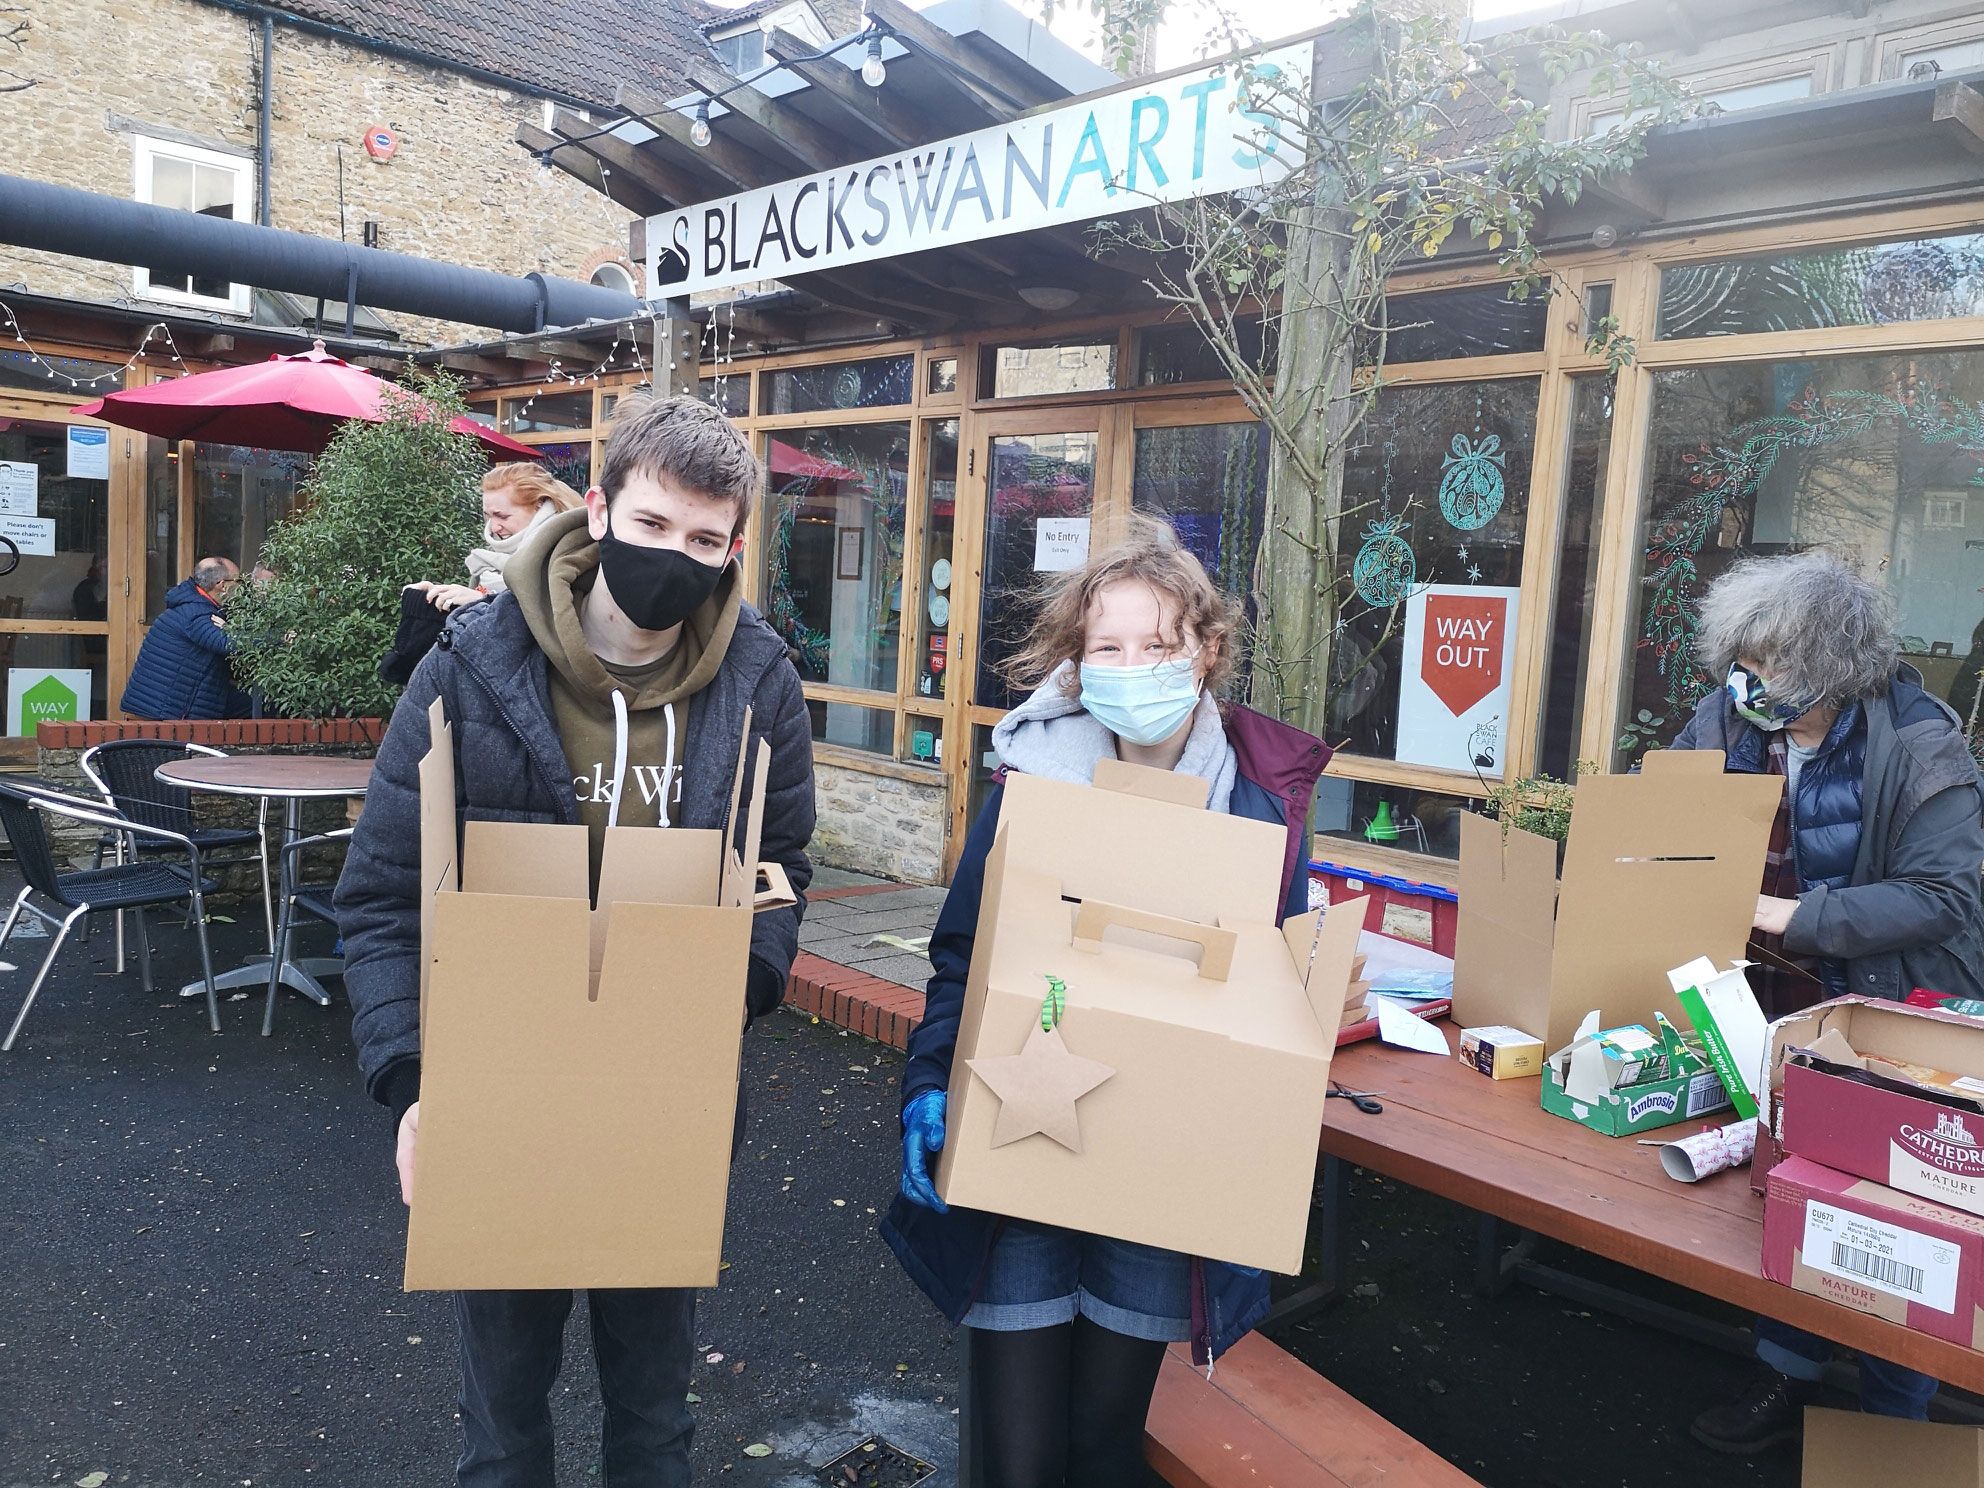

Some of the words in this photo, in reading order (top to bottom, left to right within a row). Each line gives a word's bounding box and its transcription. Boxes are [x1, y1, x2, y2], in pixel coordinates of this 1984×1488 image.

[22, 530, 39, 538] chairs
[1045, 532, 1056, 541] No
[1058, 532, 1080, 543] Entry
[1436, 617, 1493, 641] WAY
[932, 656, 944, 665] PRS
[1436, 644, 1490, 669] OUT
[30, 702, 69, 714] WAY
[1476, 723, 1497, 731] BLACK
[1476, 730, 1497, 738] SWAN
[1704, 1030, 1720, 1055] Butter
[1716, 1054, 1732, 1073] Irish
[1726, 1073, 1740, 1093] Pure
[1630, 1095, 1675, 1119] Ambrosia
[1900, 1124, 1984, 1164] CATHEDR
[1934, 1156, 1964, 1171] CITY
[1920, 1170, 1976, 1194] MATURE
[1812, 1208, 1835, 1222] CU673
[1906, 1203, 1984, 1228] MATU
[1822, 1276, 1877, 1302] MATURE
[1829, 1290, 1868, 1308] CHEDDAR
